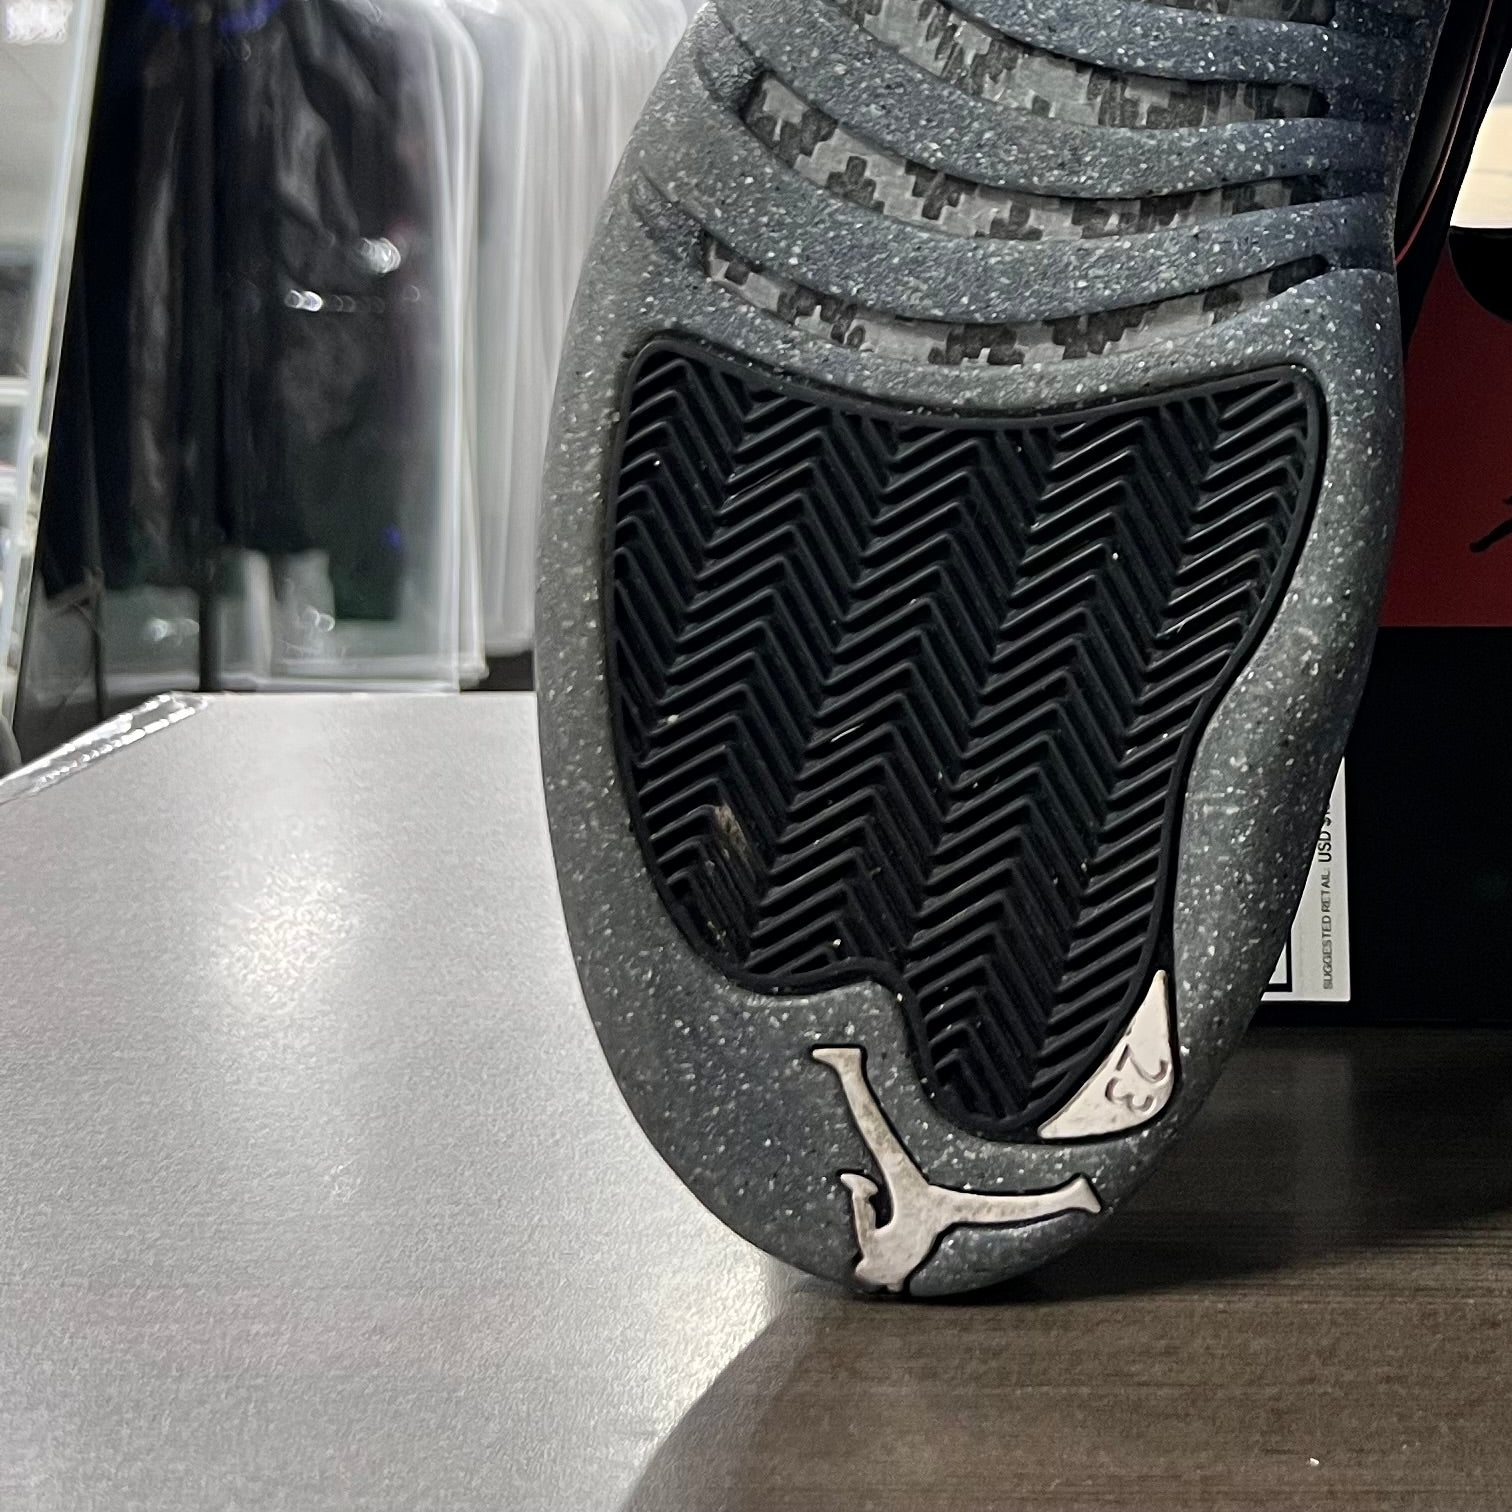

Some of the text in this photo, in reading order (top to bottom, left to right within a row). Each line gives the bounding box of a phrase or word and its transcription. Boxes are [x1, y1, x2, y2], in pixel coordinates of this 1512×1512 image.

[1317, 830, 1332, 863] USD
[1321, 915, 1333, 989] SUGGESTED
[1105, 1044, 1169, 1113] 23
